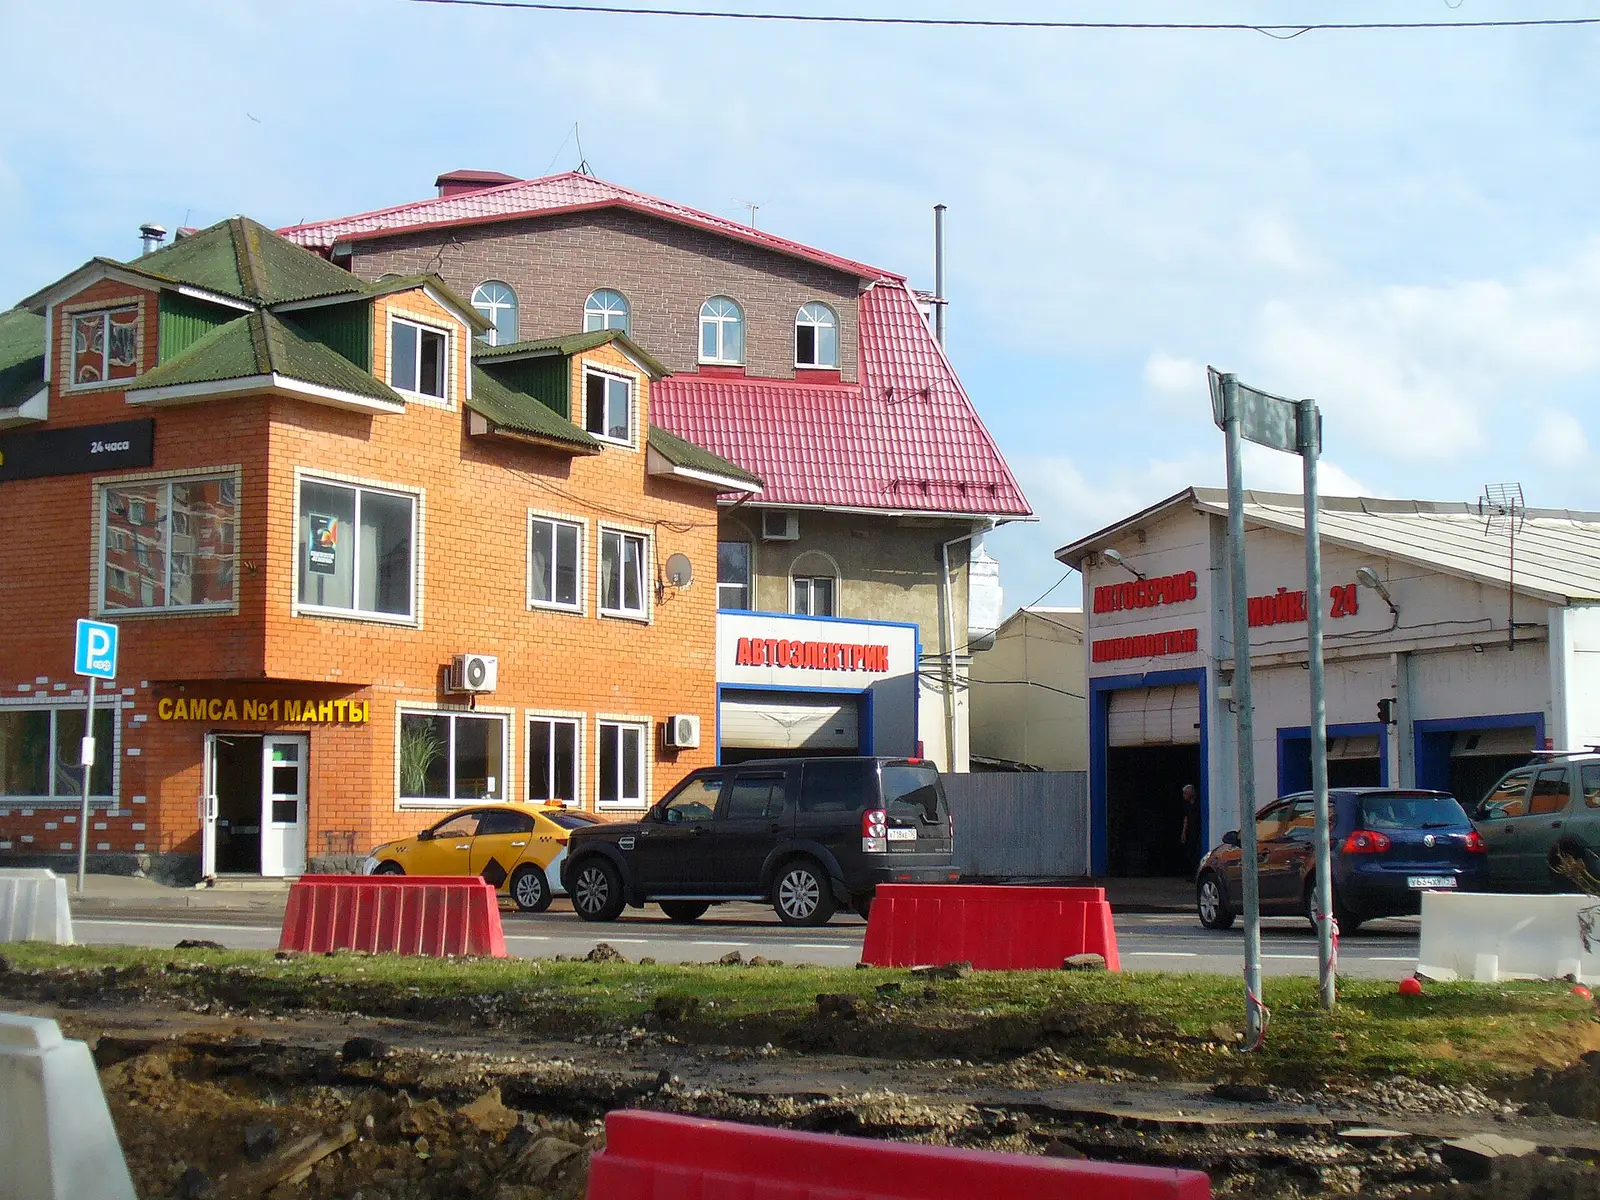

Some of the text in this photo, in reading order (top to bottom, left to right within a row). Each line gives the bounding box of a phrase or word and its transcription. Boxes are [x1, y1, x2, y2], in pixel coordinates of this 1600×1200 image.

[90, 440, 130, 453] 24 часа
[1093, 570, 1197, 614] АВТОСЕРВИС
[1247, 583, 1359, 628] МОЙК 24
[86, 628, 110, 669] P
[736, 637, 889, 672] АВТОЭЛЕКТРИК
[1092, 628, 1198, 663] ШИНОМОНТАЖ
[158, 698, 369, 723] САМСА №1 МАНТЫ
